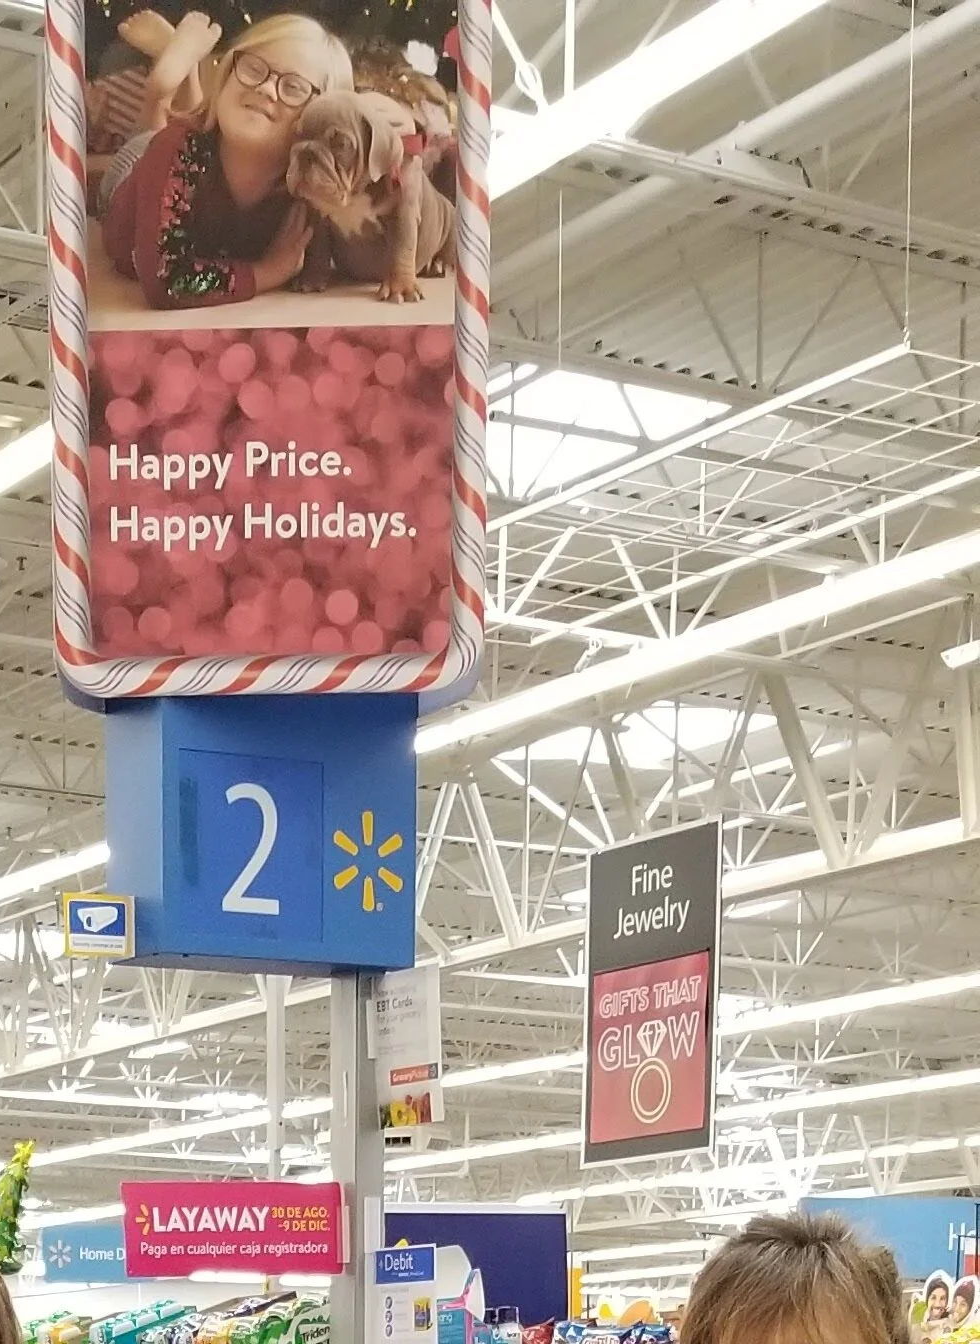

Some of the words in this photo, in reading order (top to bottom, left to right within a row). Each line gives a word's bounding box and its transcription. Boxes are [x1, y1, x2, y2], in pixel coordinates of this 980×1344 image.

[109, 443, 233, 491] Happy
[245, 440, 352, 477] Price.
[109, 506, 233, 551] Happy
[244, 501, 417, 549] Holidays.
[222, 782, 280, 915] 2
[632, 865, 674, 896] Fine
[613, 897, 690, 939] Jewelry
[599, 986, 650, 1019] GIFTS
[653, 975, 702, 1006] THAT
[152, 1205, 270, 1233] LAYAWAY
[271, 1206, 284, 1219] 30
[286, 1206, 303, 1219] DE
[304, 1206, 330, 1219] AGO.
[291, 1220, 308, 1232] DE
[309, 1220, 331, 1232] DIC.
[80, 1246, 115, 1260] Home
[116, 1247, 126, 1260] D
[140, 1241, 166, 1257] Paga
[170, 1245, 184, 1255] en
[187, 1241, 236, 1257] cualquier
[239, 1242, 261, 1257] caja
[263, 1241, 328, 1257] registradora
[384, 1252, 414, 1271] Debit
[300, 1326, 330, 1344] Triden
